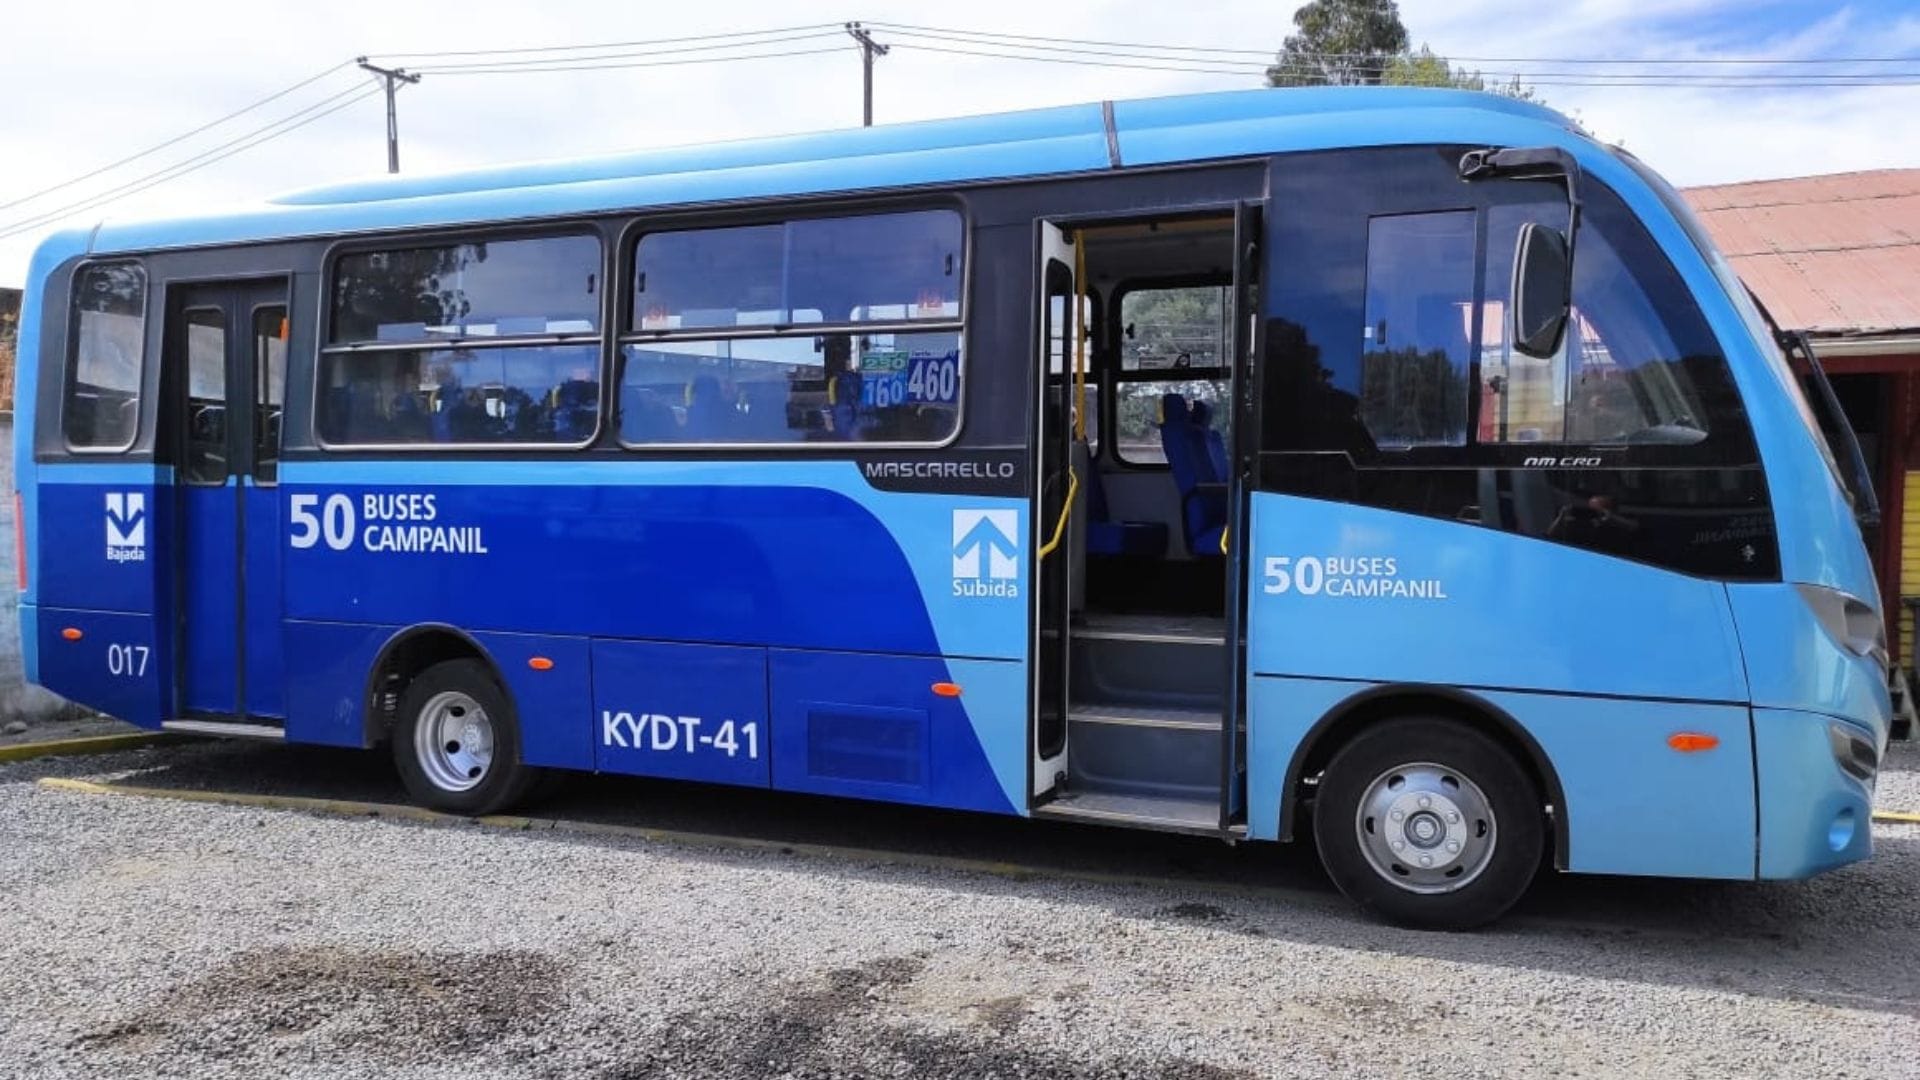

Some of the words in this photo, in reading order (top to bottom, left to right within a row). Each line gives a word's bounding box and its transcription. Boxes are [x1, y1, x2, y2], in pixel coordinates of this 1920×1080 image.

[864, 377, 903, 408] 160
[908, 359, 954, 401] 460
[866, 462, 1015, 477] MASCARELLO
[364, 493, 437, 520] BUSES
[290, 493, 355, 550] 50
[363, 525, 488, 554] CAMPANIL
[107, 547, 145, 562] Bajada
[1325, 557, 1397, 576] BUSES
[952, 579, 1018, 598] Subida
[1263, 556, 1323, 595] 50
[1325, 578, 1447, 599] CAMPANIL
[108, 643, 149, 677] 017
[602, 711, 759, 759] KYDT-41
